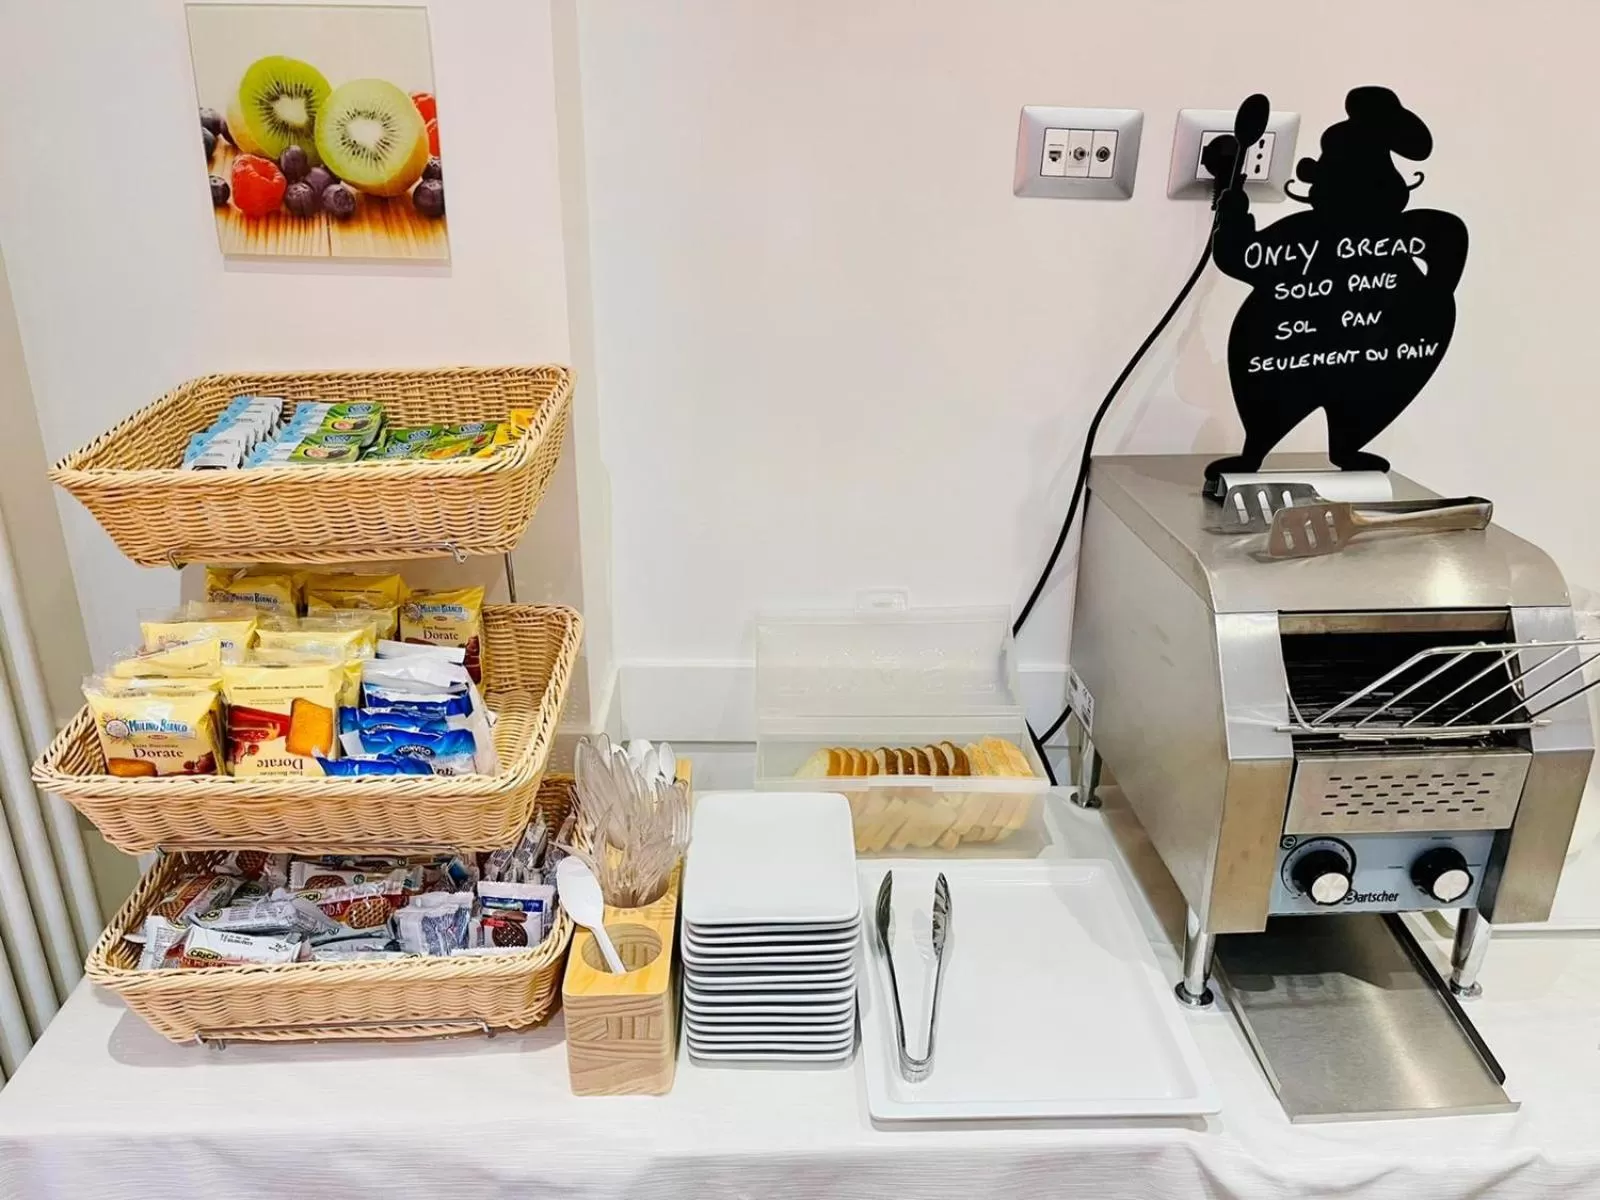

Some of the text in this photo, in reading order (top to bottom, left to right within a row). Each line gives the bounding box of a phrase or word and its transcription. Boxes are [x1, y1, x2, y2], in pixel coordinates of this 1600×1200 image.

[1244, 237, 1426, 275] ONLY BREAD
[1274, 272, 1398, 300] SOLO PANE
[1274, 310, 1382, 340] SOL PAN
[1248, 349, 1360, 373] SEULEMENT
[424, 630, 459, 640] Dorate
[133, 748, 184, 758] Dorate
[256, 758, 304, 770] Dorate
[190, 949, 218, 960] CRICH
